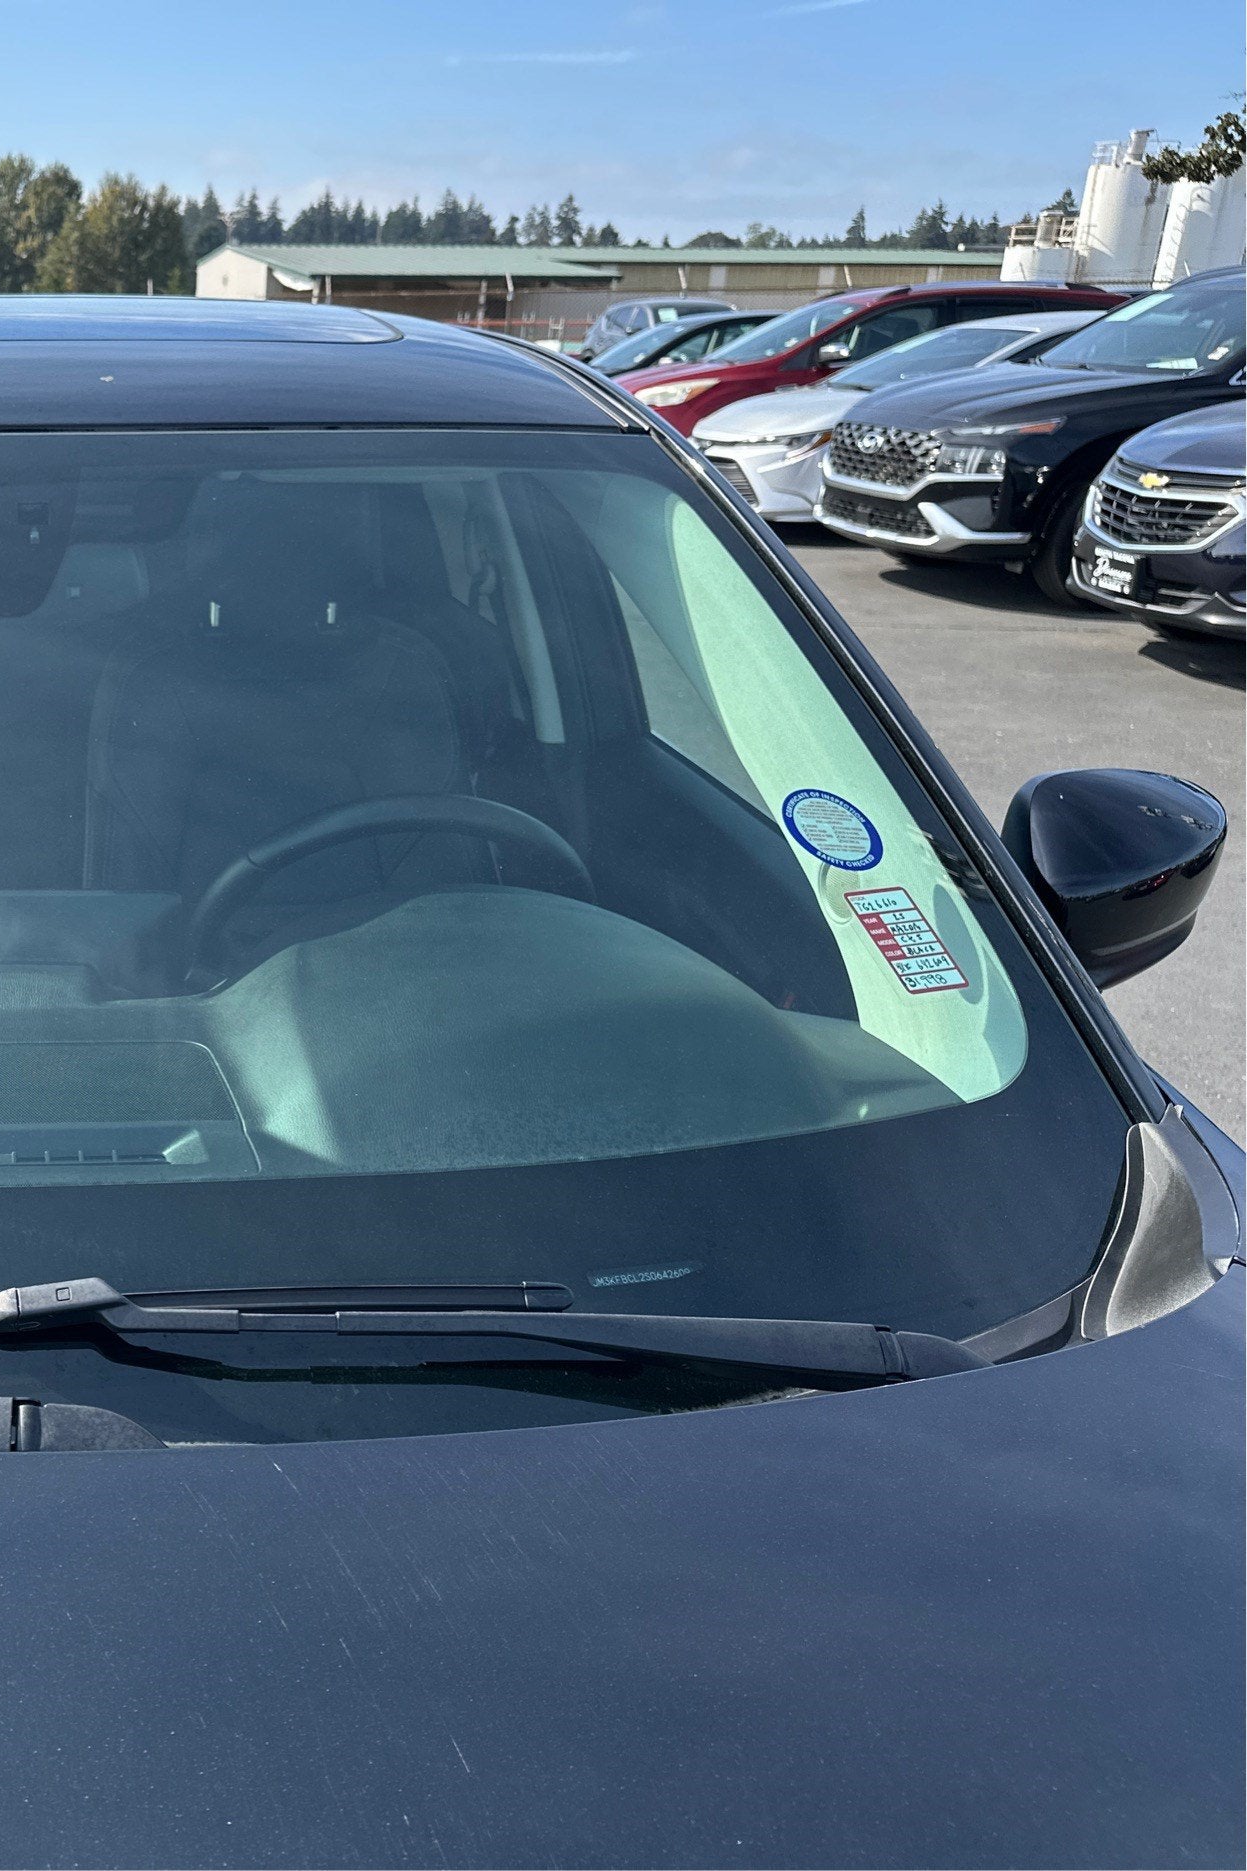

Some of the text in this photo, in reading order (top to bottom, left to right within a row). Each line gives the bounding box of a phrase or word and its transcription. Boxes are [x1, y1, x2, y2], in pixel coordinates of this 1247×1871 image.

[821, 793, 866, 823] INSPECTION
[816, 851, 844, 866] SAFETY
[863, 917, 878, 925] YEAR
[884, 949, 903, 957] COLOR
[907, 945, 935, 956] BLACK
